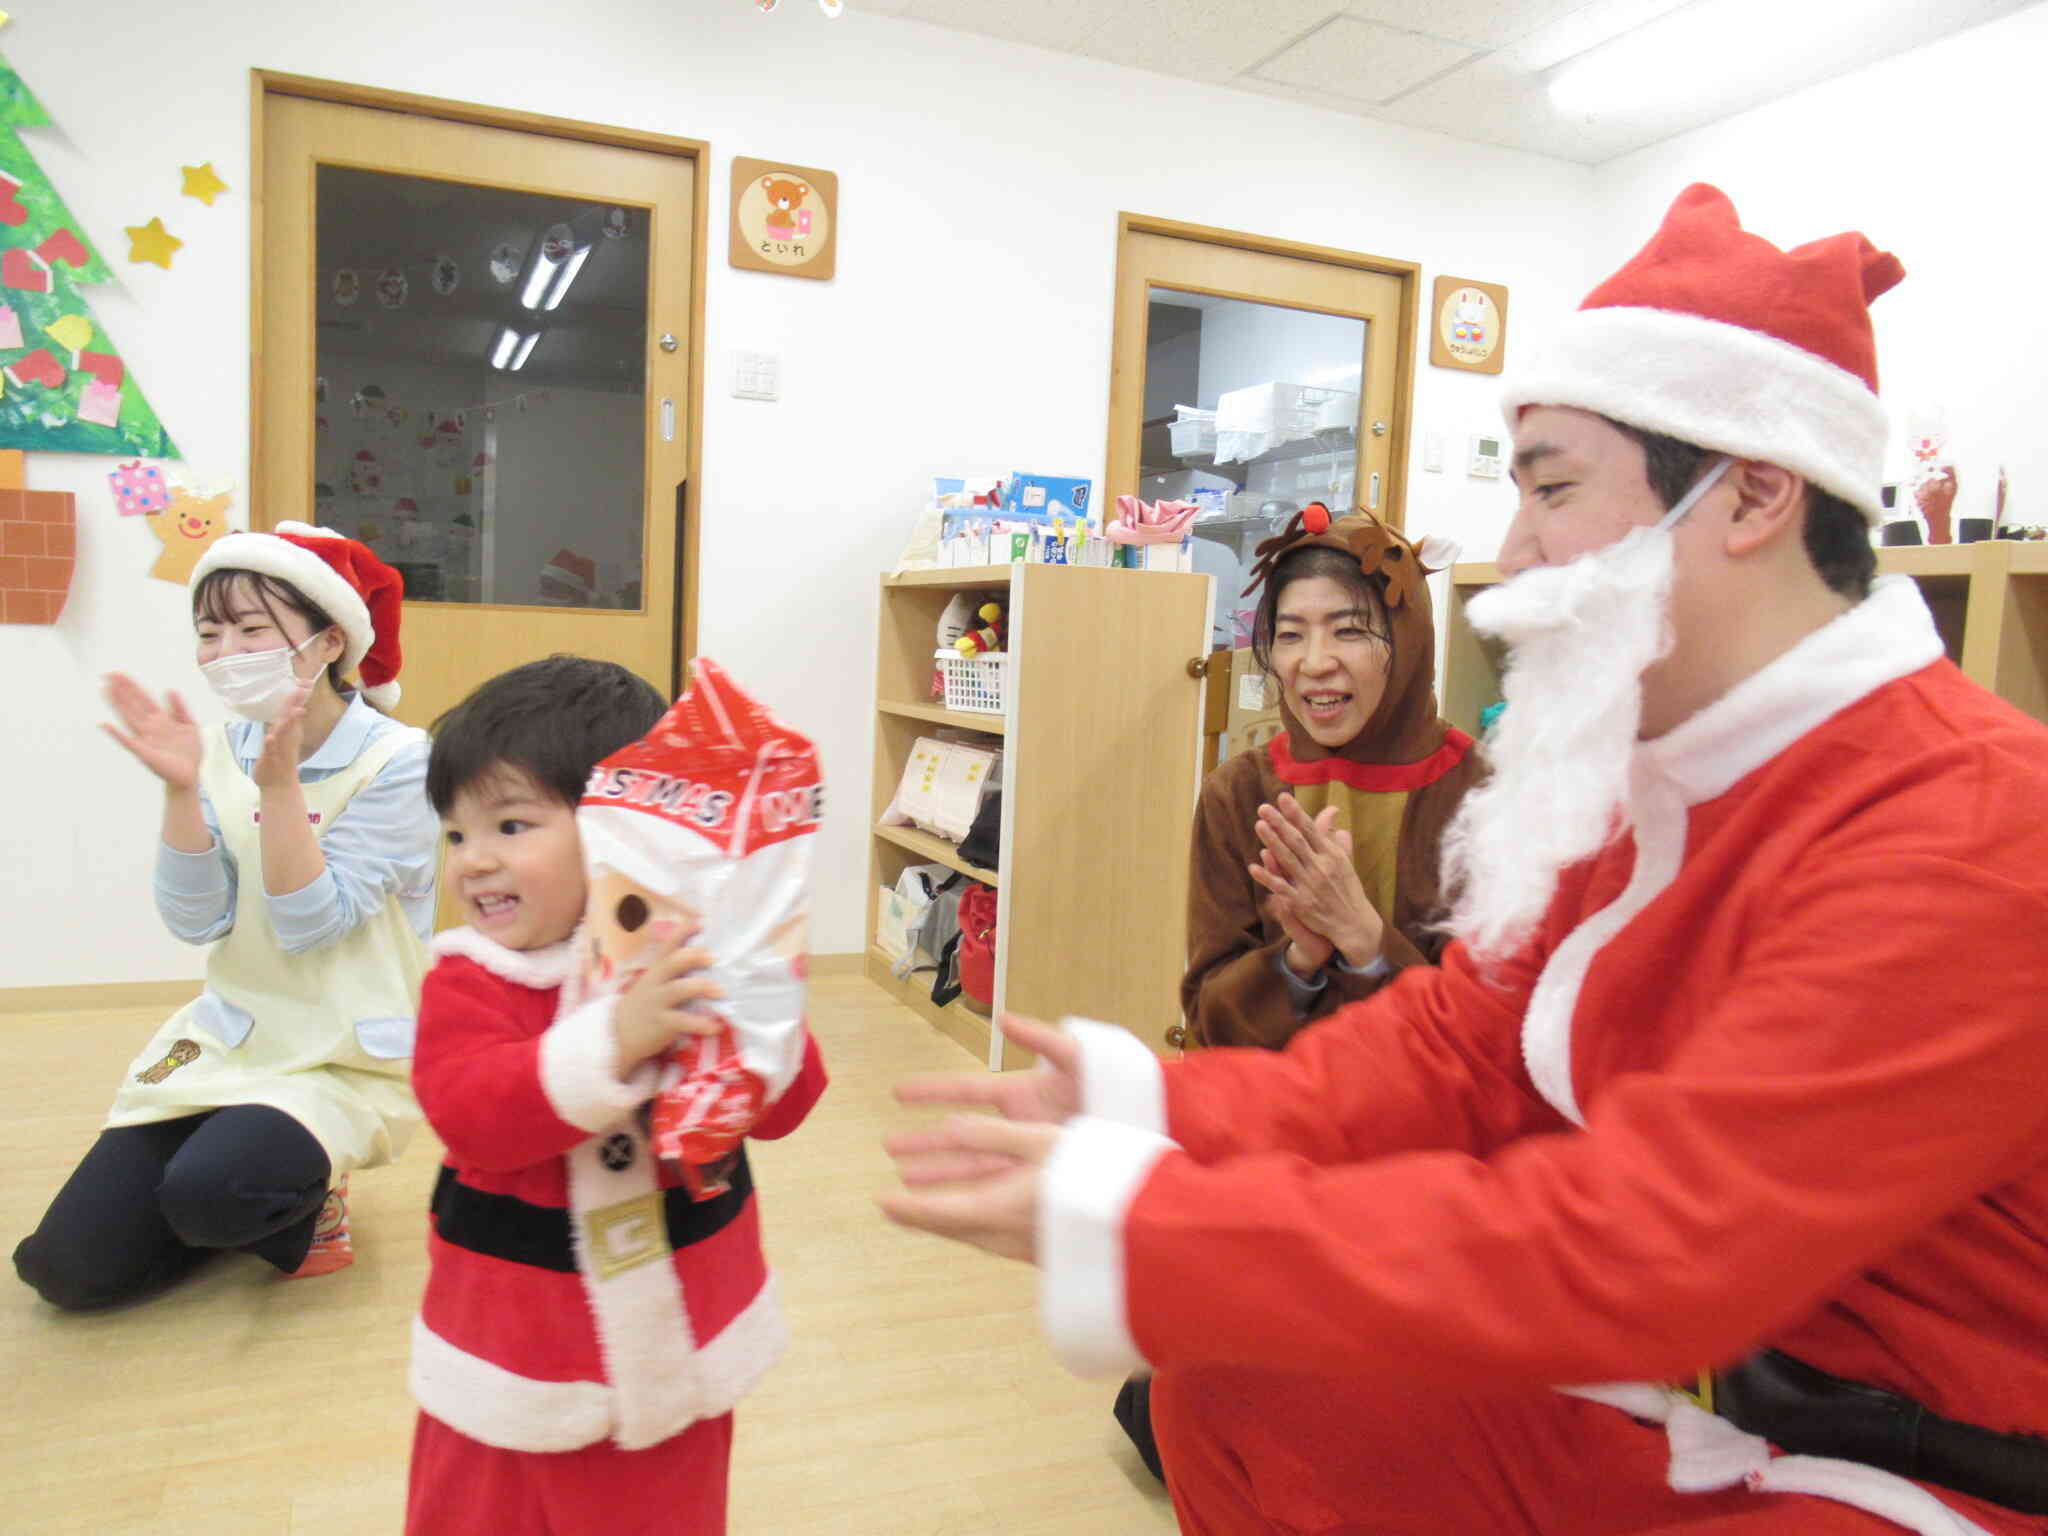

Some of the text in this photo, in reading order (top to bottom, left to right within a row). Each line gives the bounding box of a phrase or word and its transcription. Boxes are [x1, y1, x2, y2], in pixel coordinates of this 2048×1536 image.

[760, 241, 805, 257] といれ
[585, 766, 735, 827] ISTMAS
